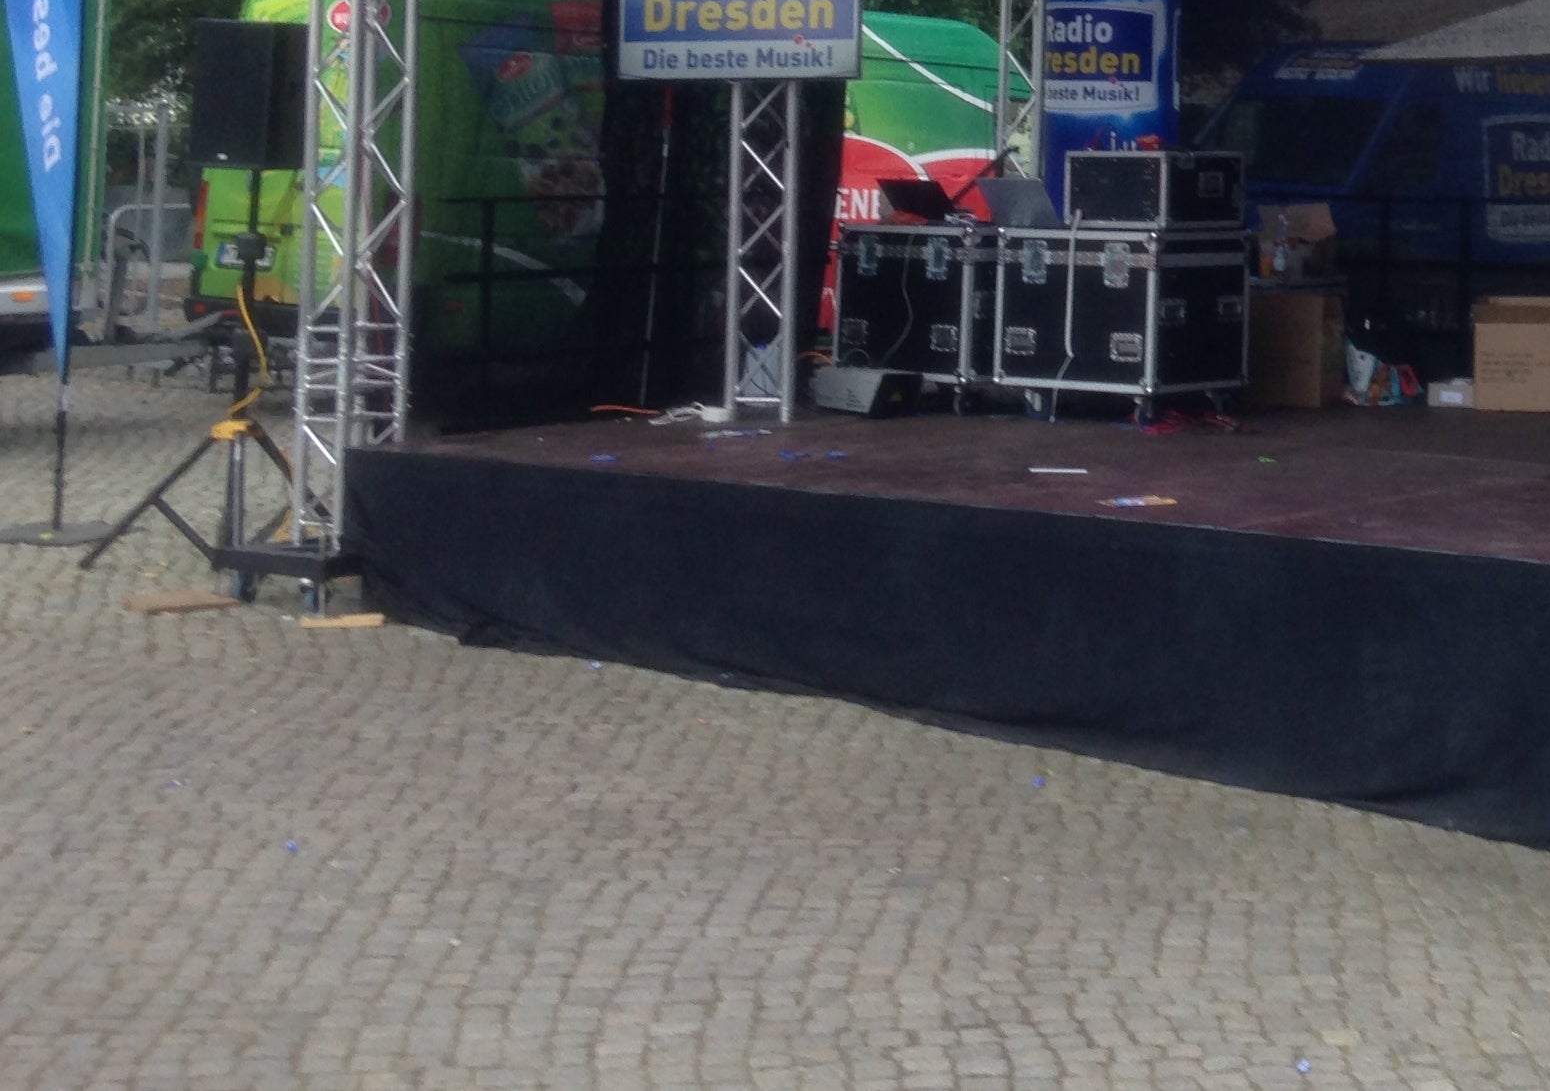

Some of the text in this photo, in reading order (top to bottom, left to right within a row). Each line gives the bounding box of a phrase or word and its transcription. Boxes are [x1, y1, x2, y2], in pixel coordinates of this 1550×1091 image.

[643, 44, 835, 70] Die beste Musik!
